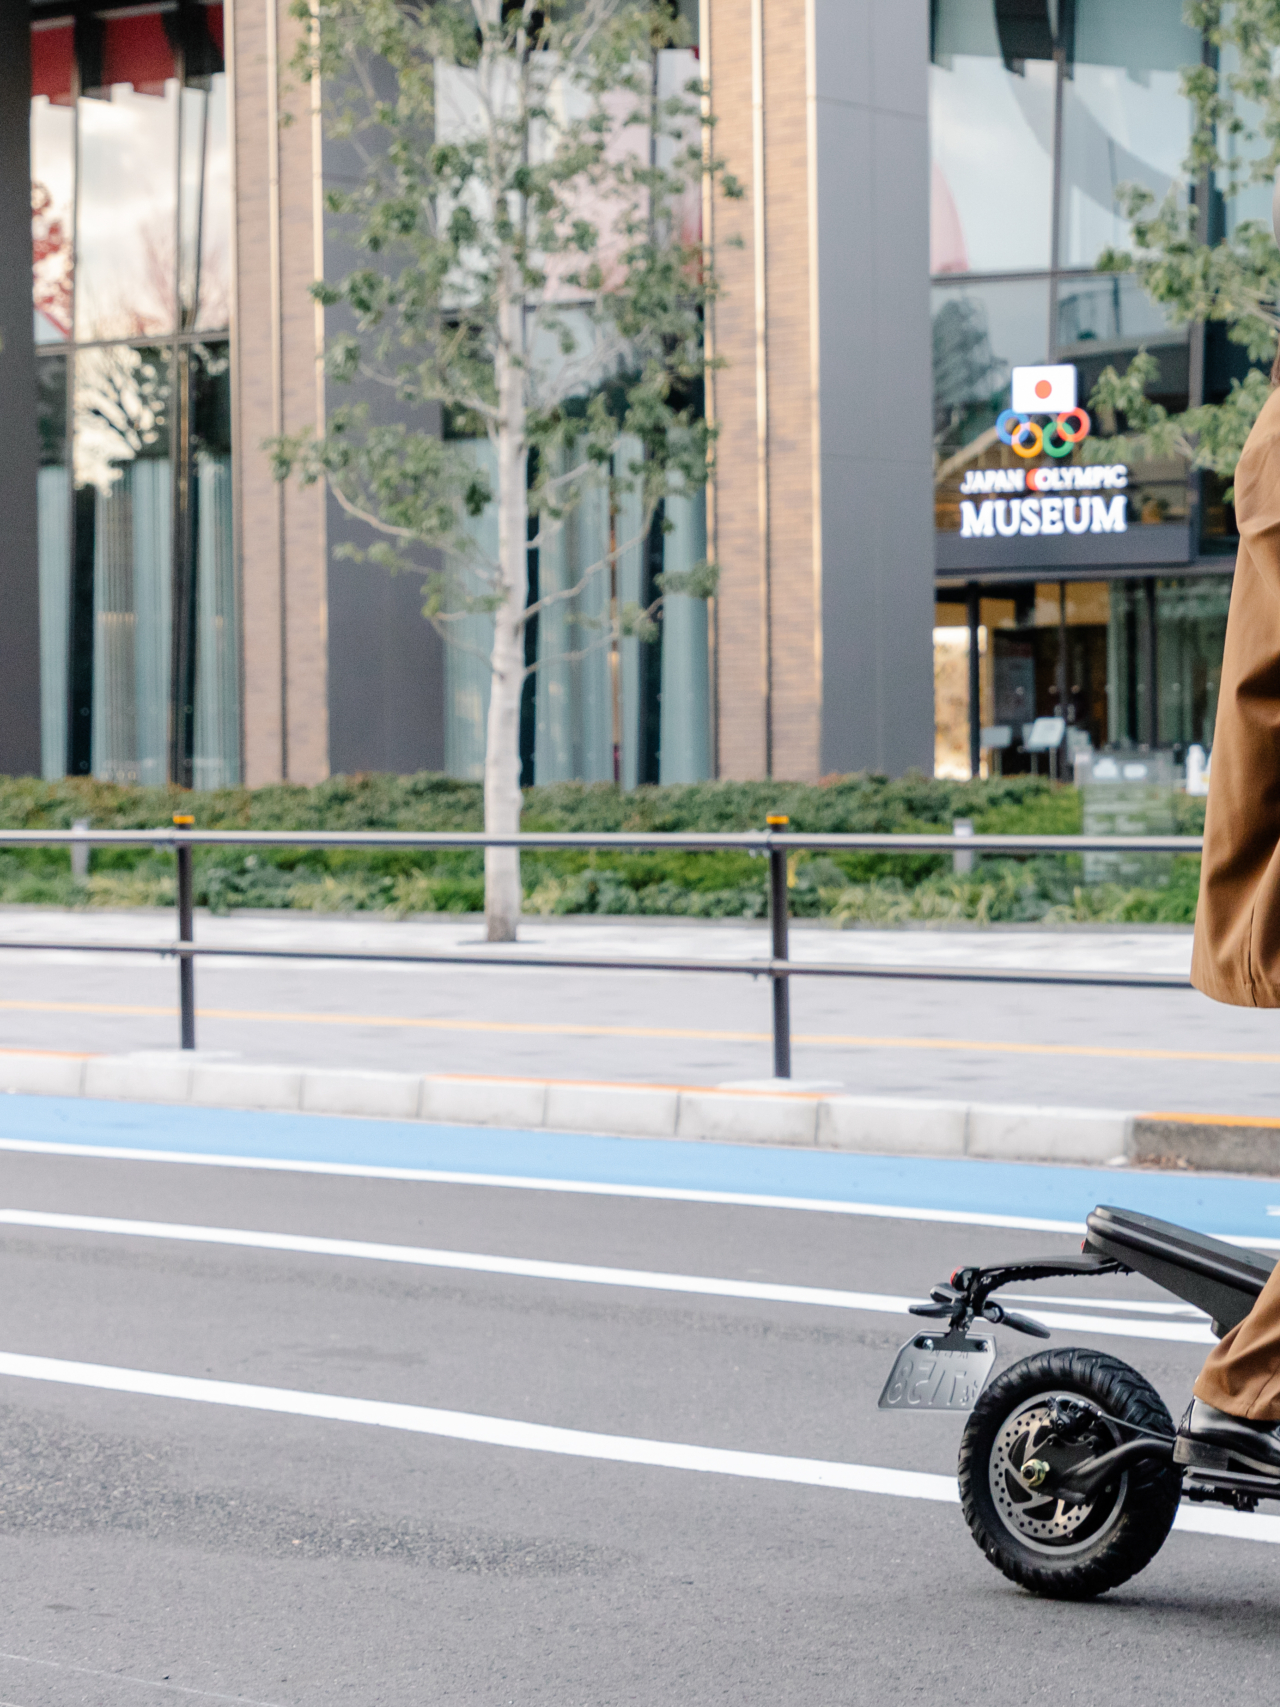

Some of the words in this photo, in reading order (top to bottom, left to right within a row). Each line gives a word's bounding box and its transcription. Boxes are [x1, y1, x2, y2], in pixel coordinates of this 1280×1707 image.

[961, 468, 1025, 494] JAPAN
[1035, 465, 1128, 491] OLYMPIC
[960, 495, 1128, 538] MUSEUM
